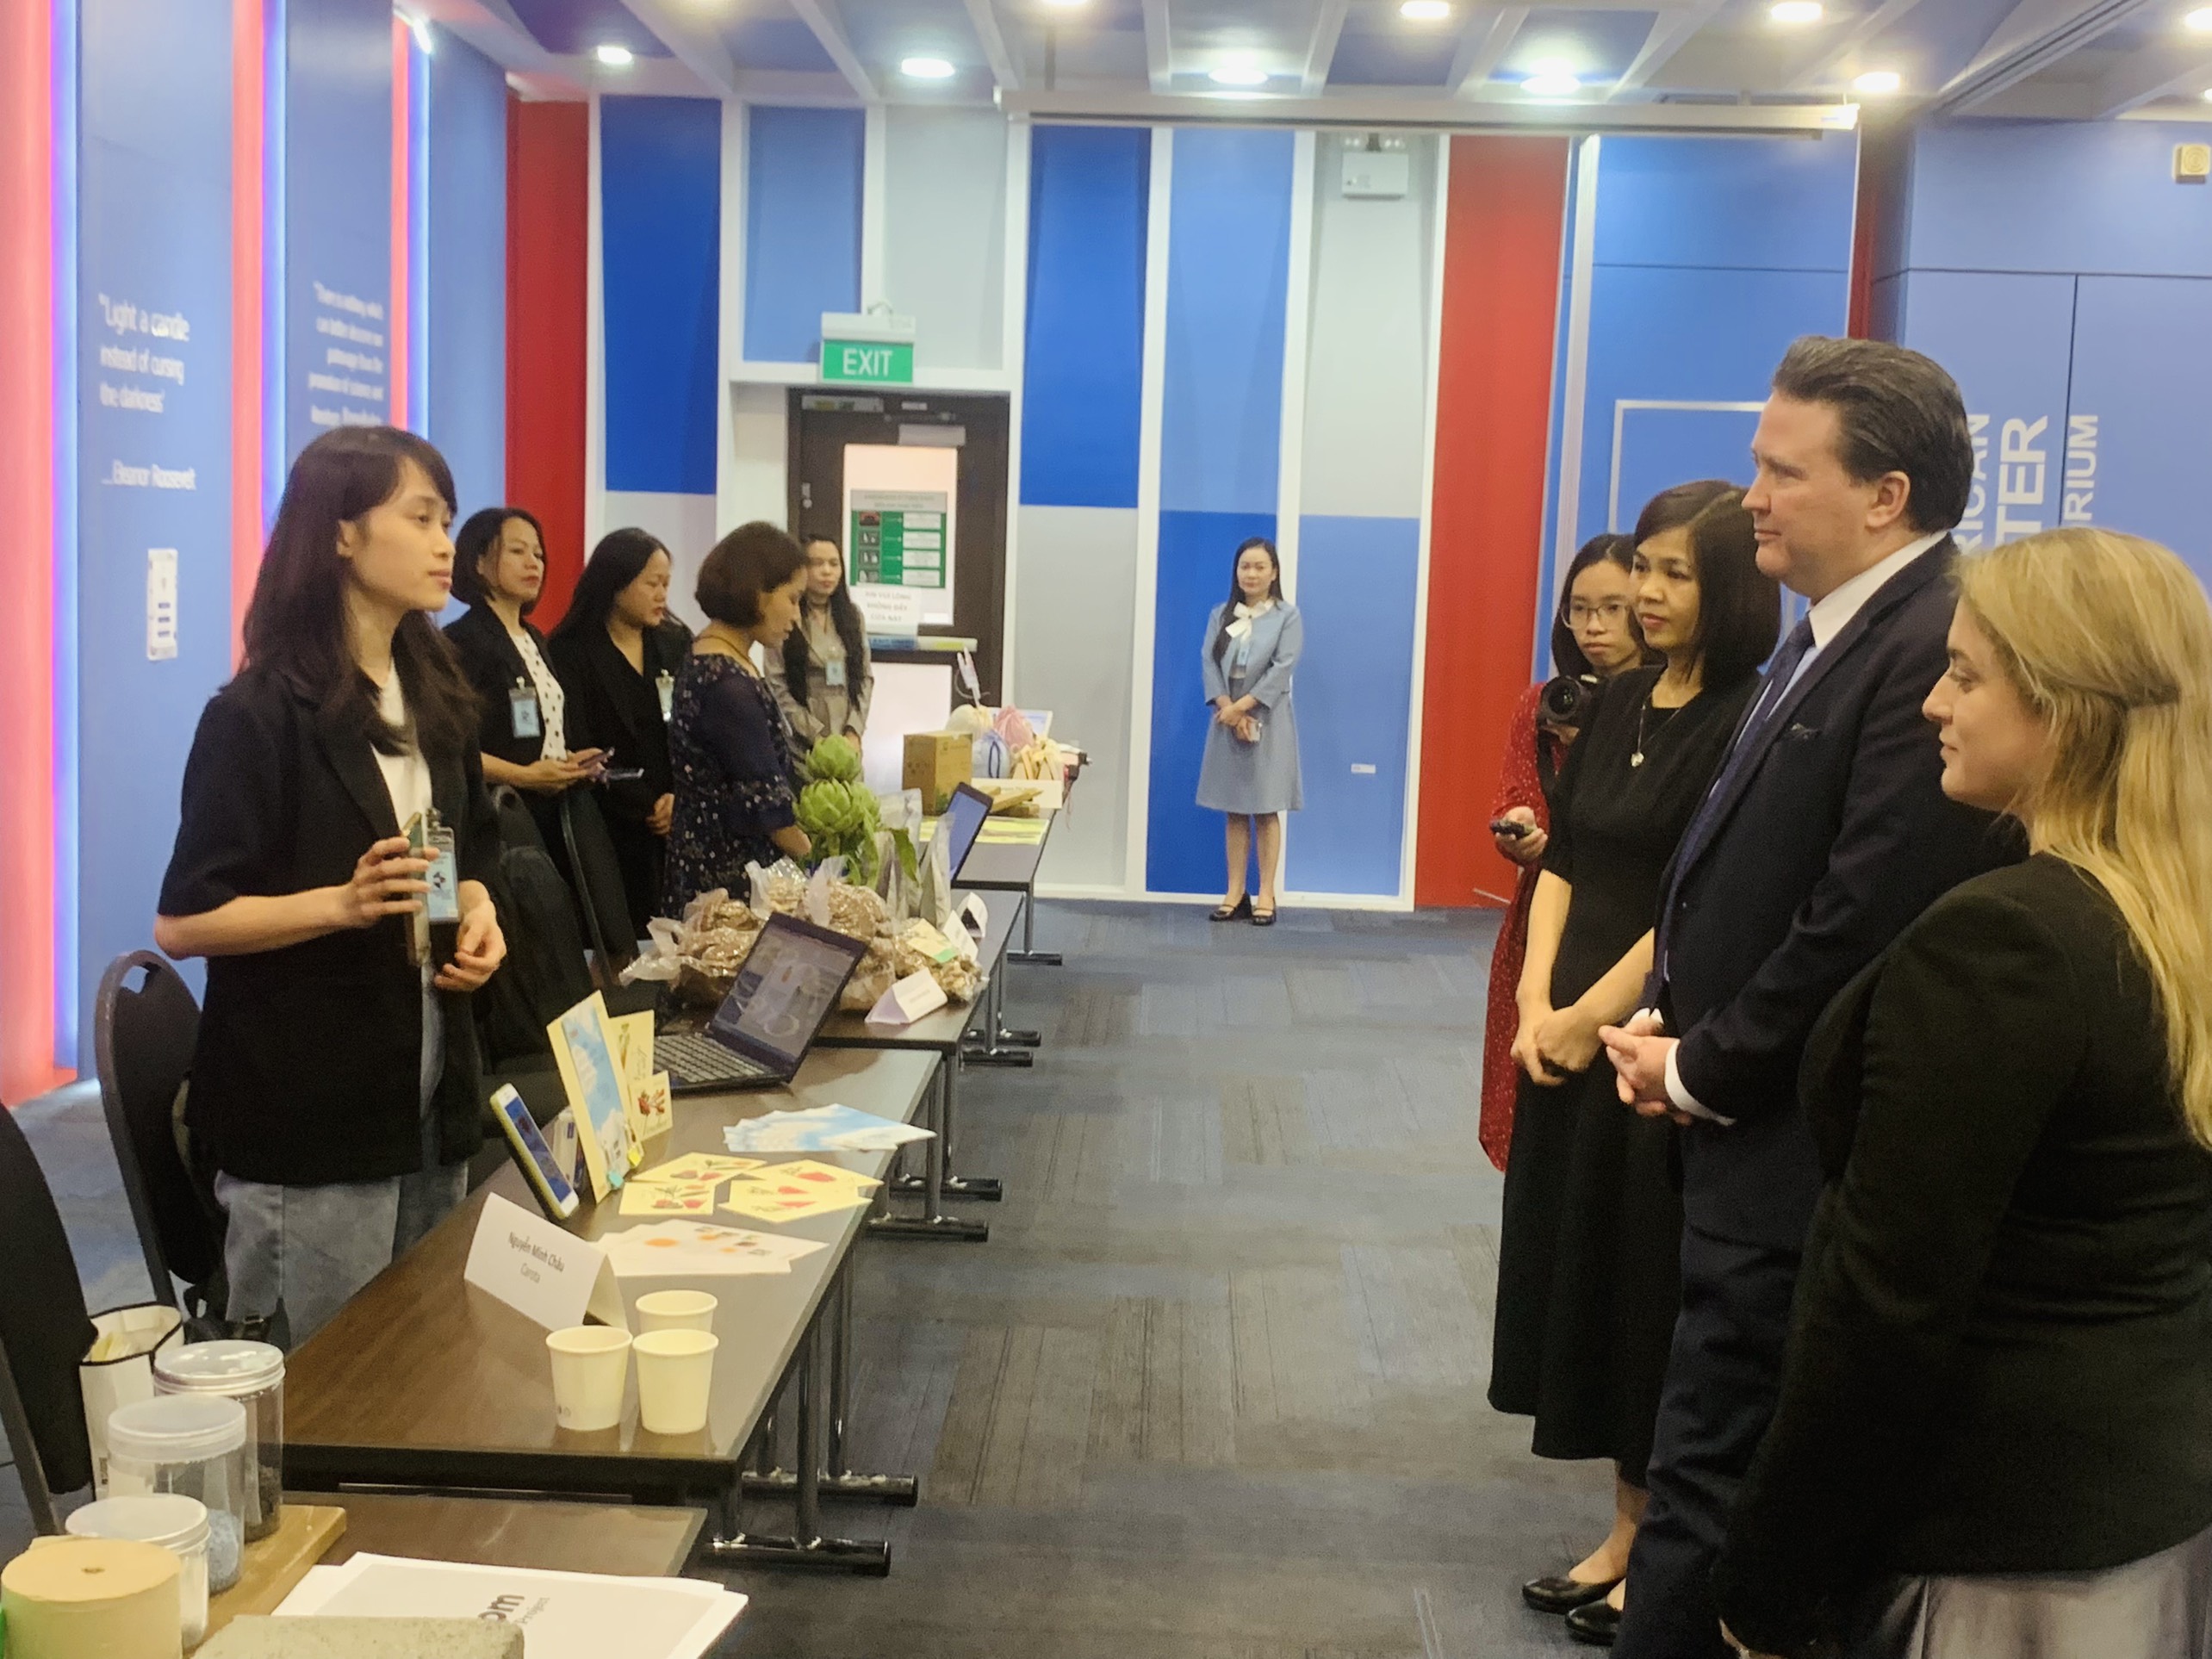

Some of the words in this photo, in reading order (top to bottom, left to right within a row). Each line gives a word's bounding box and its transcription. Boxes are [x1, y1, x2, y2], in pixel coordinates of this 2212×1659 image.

[842, 347, 893, 377] EXIT
[1952, 413, 1991, 556] RICAN
[1995, 415, 2048, 548] TER
[2063, 415, 2098, 521] RIUM
